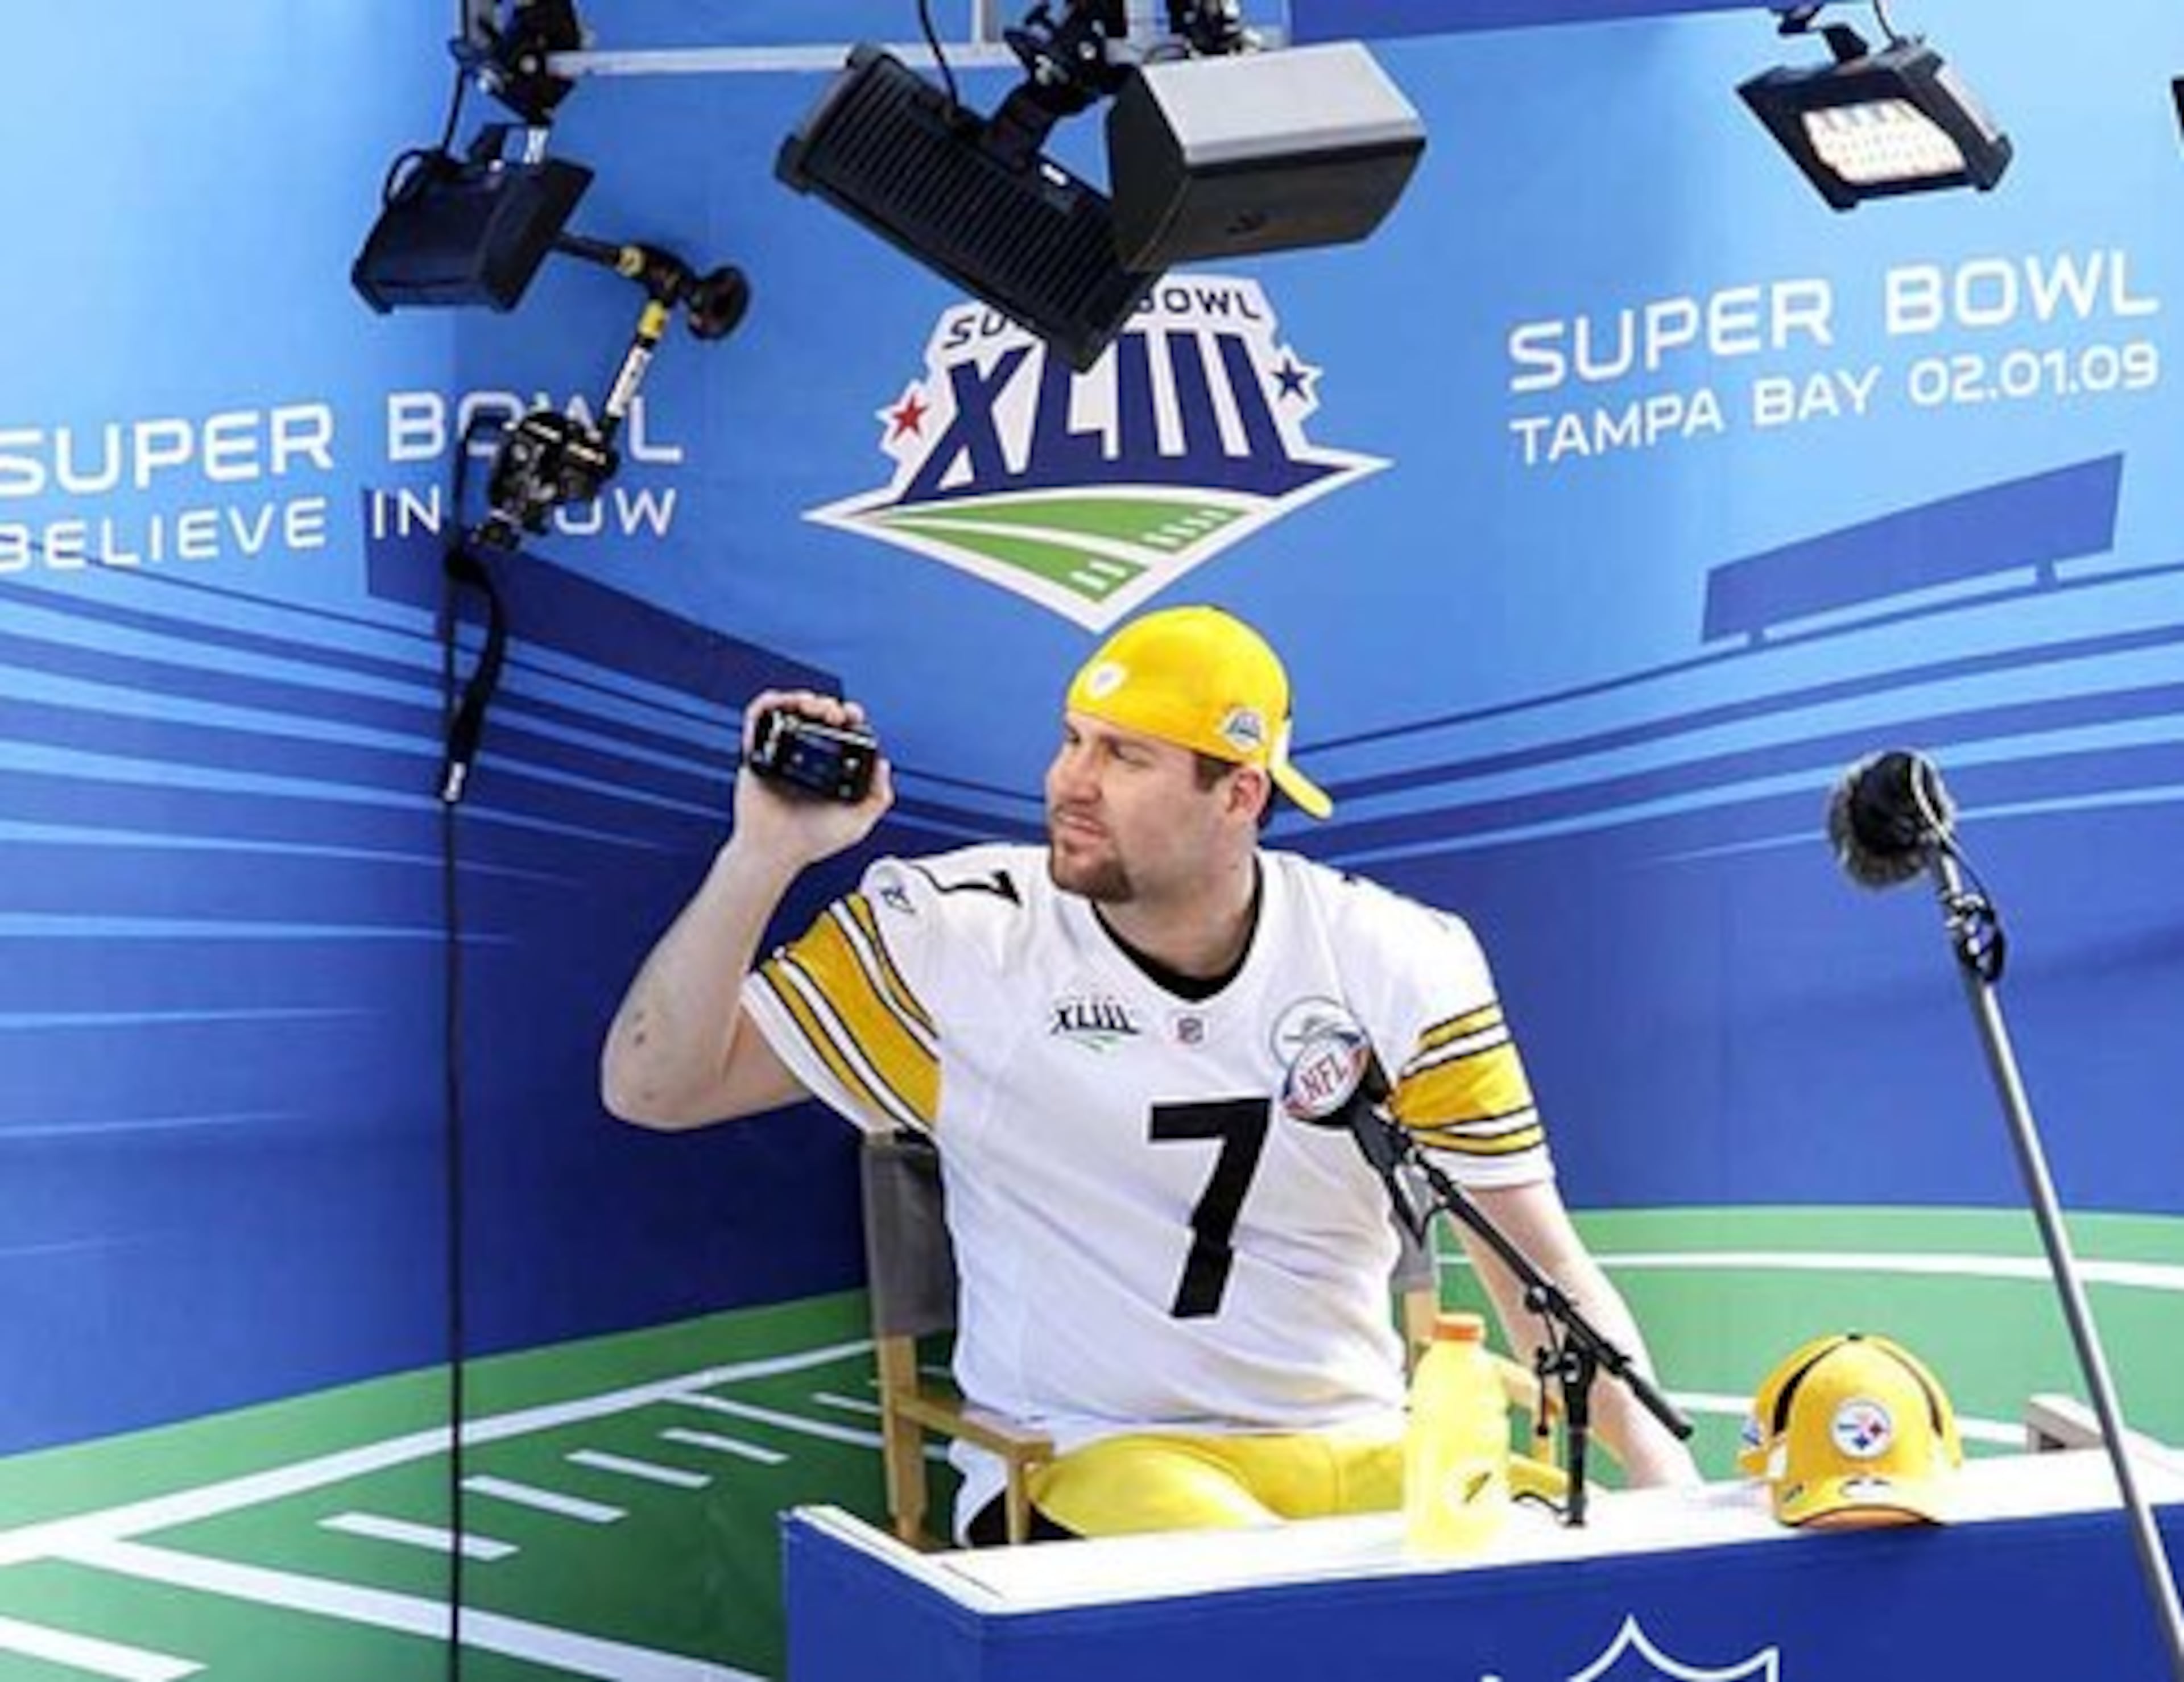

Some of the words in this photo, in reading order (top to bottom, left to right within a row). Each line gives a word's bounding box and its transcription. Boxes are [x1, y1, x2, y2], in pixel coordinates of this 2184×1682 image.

[1508, 277, 1833, 391] SUPER
[1885, 250, 2158, 334] BOWL
[0, 403, 334, 497] SUPER
[899, 331, 1351, 505] XLIII
[1509, 388, 1724, 465] TAMPA
[1753, 366, 1881, 426] BAY
[1908, 341, 2159, 404] 02.01.09
[0, 497, 326, 570] BELIEVE
[373, 485, 441, 539] IN
[554, 487, 677, 536] OW
[1299, 1052, 1349, 1104] NFL
[1148, 1098, 1272, 1319] 7
